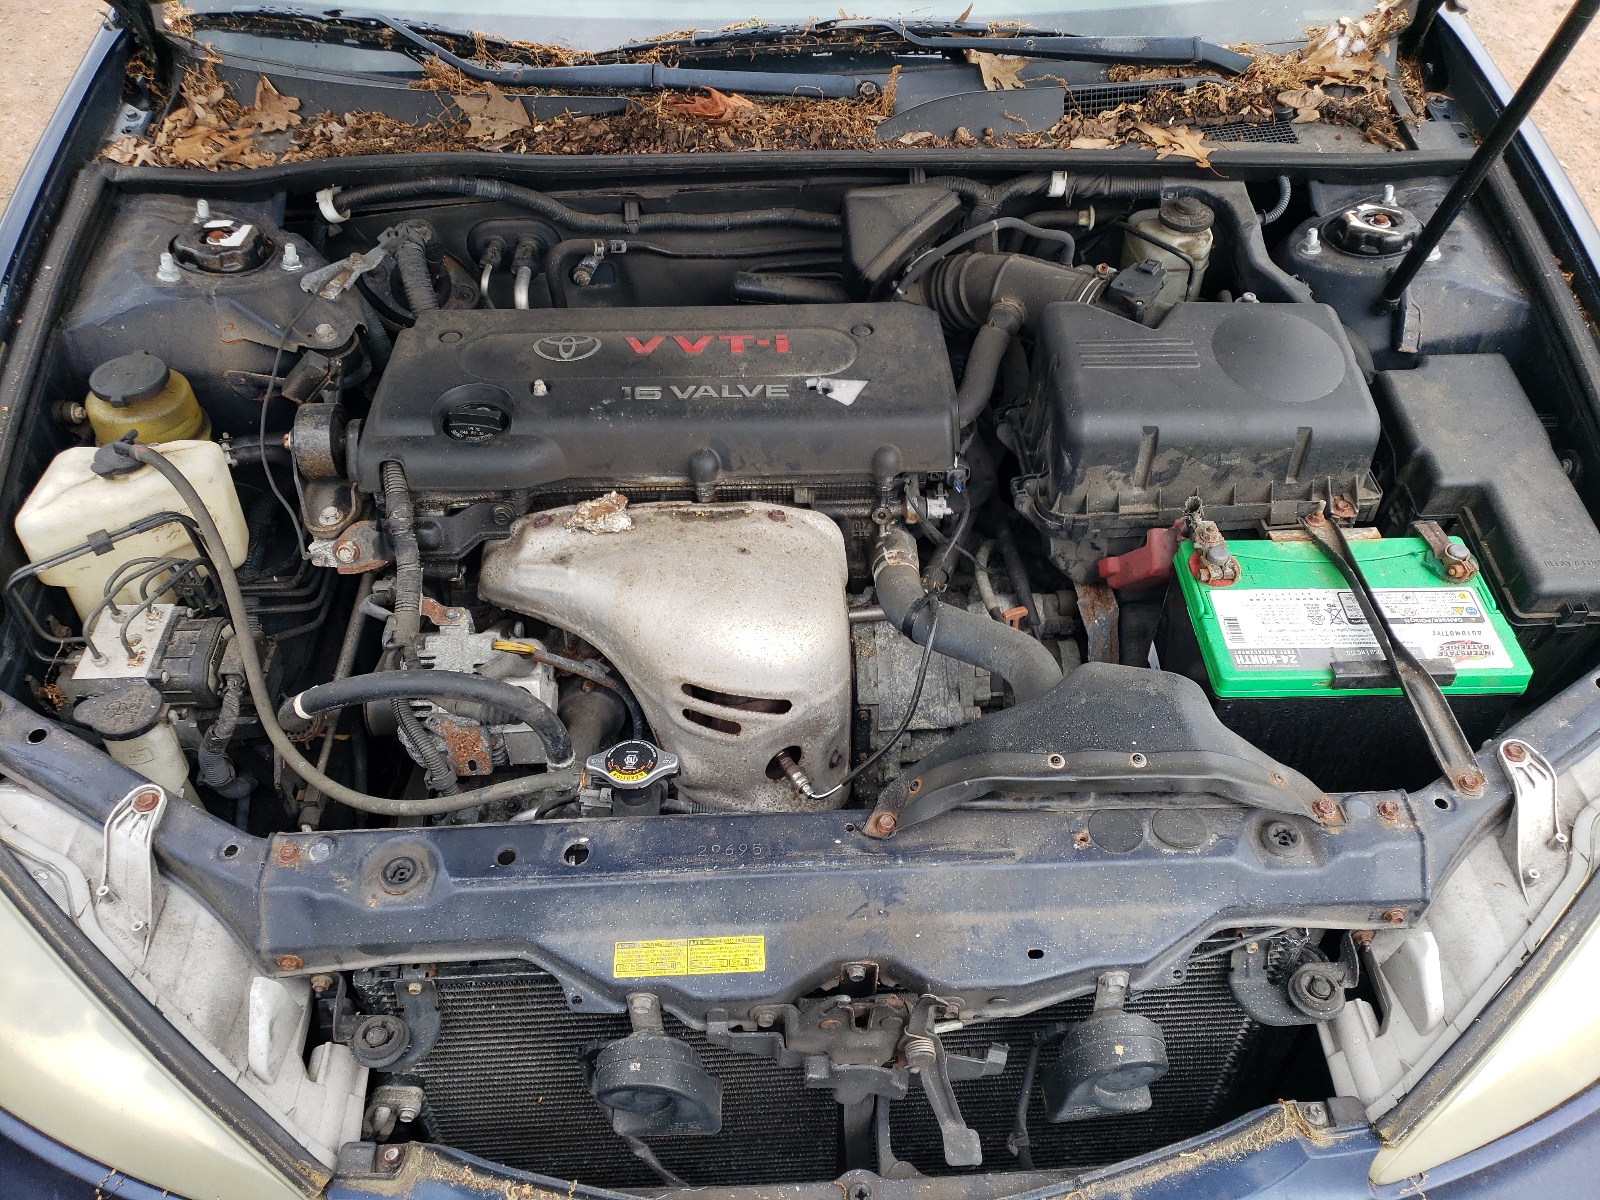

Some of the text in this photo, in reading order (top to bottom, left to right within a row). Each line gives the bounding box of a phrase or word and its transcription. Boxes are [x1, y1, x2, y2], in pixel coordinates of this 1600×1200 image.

[623, 334, 789, 354] VVT-i
[621, 384, 790, 401] 16 VALVE
[1233, 654, 1299, 665] 24-MONTH
[697, 843, 763, 857] 29695
